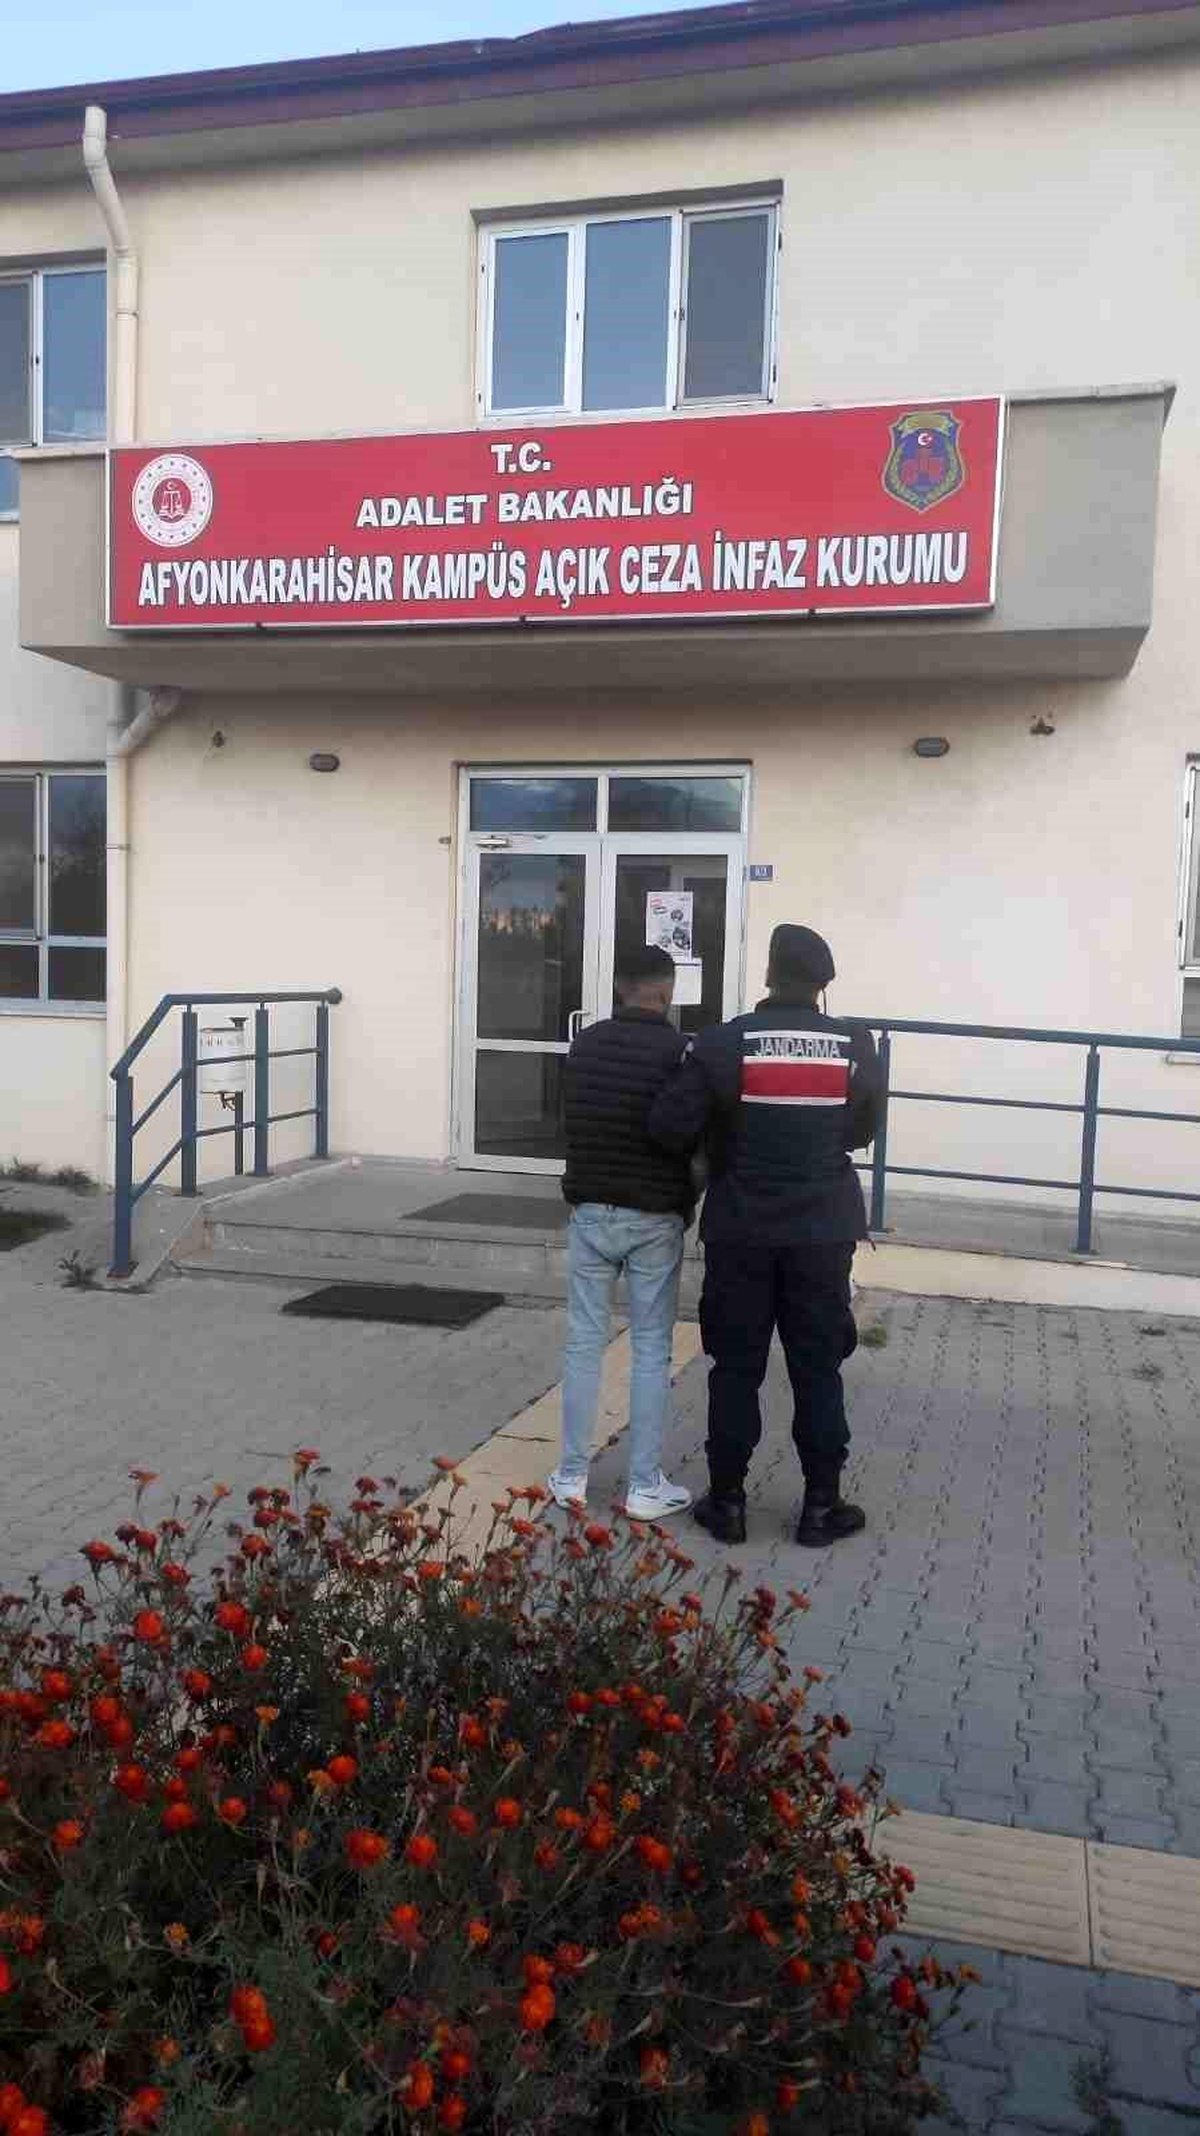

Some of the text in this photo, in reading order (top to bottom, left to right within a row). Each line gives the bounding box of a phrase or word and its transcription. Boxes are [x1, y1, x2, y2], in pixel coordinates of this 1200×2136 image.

[490, 443, 551, 474] T.C.
[356, 476, 692, 528] ADALET BAKANLIĞI
[138, 530, 968, 609] AFYONKARAHİSAR KAMPÜS AÇIK CEZA İNFAZ KURUMU
[757, 1037, 841, 1058] JANDARMA
